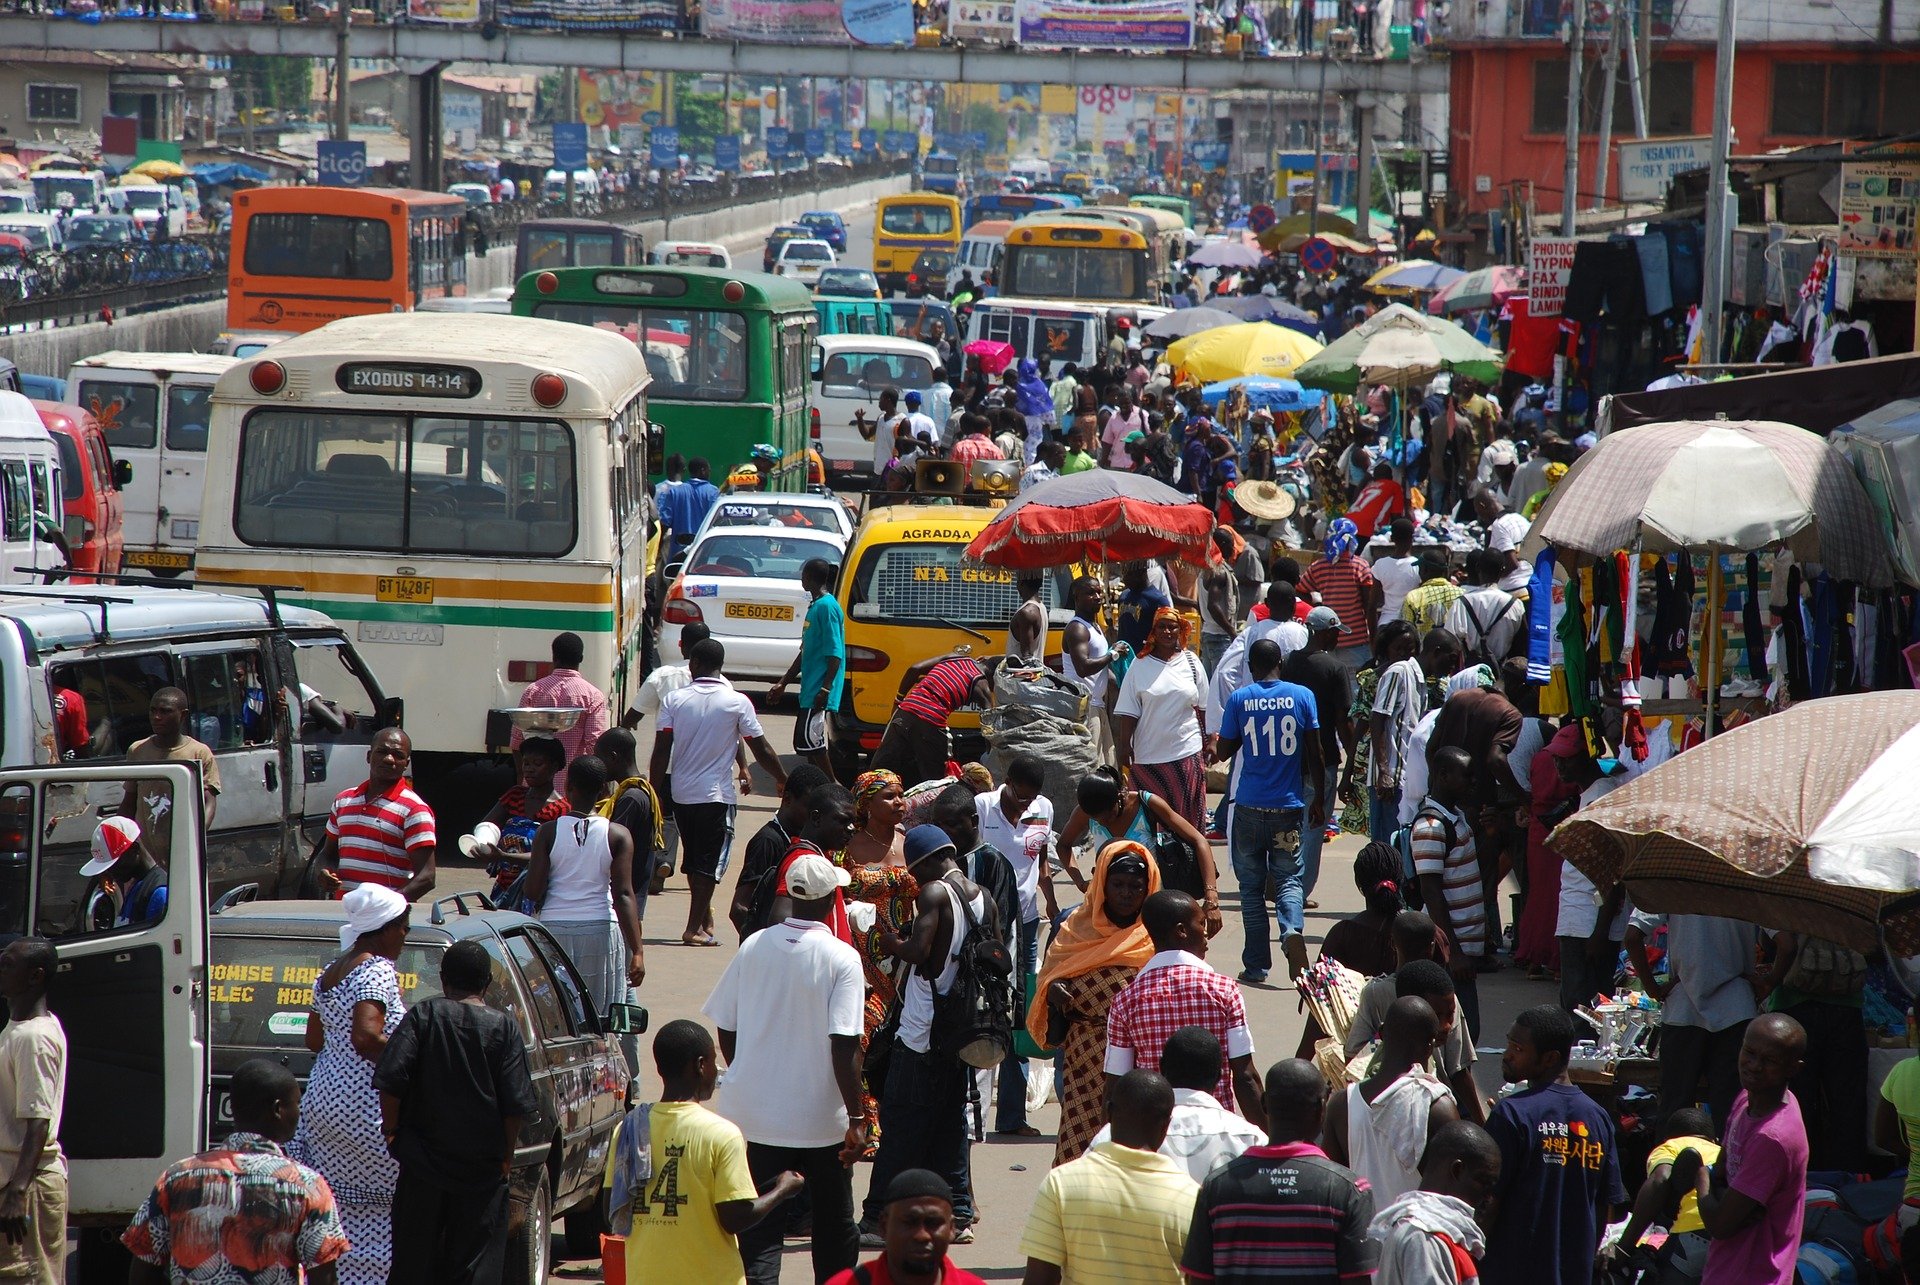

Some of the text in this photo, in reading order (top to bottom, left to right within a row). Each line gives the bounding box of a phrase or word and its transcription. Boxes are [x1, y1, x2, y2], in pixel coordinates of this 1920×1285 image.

[1533, 272, 1557, 283] FAX
[353, 371, 462, 389] EXODUS 14:14
[725, 505, 752, 515] TAXI
[902, 529, 971, 540] AGRADAA
[129, 554, 145, 565] AS
[914, 567, 949, 582] NA
[379, 580, 393, 593] GT
[728, 605, 746, 616] GE
[748, 606, 773, 618] 6031
[775, 607, 784, 619] Z
[364, 624, 437, 642] TATA
[1244, 696, 1295, 711] MICCRO
[1244, 715, 1297, 756] 118
